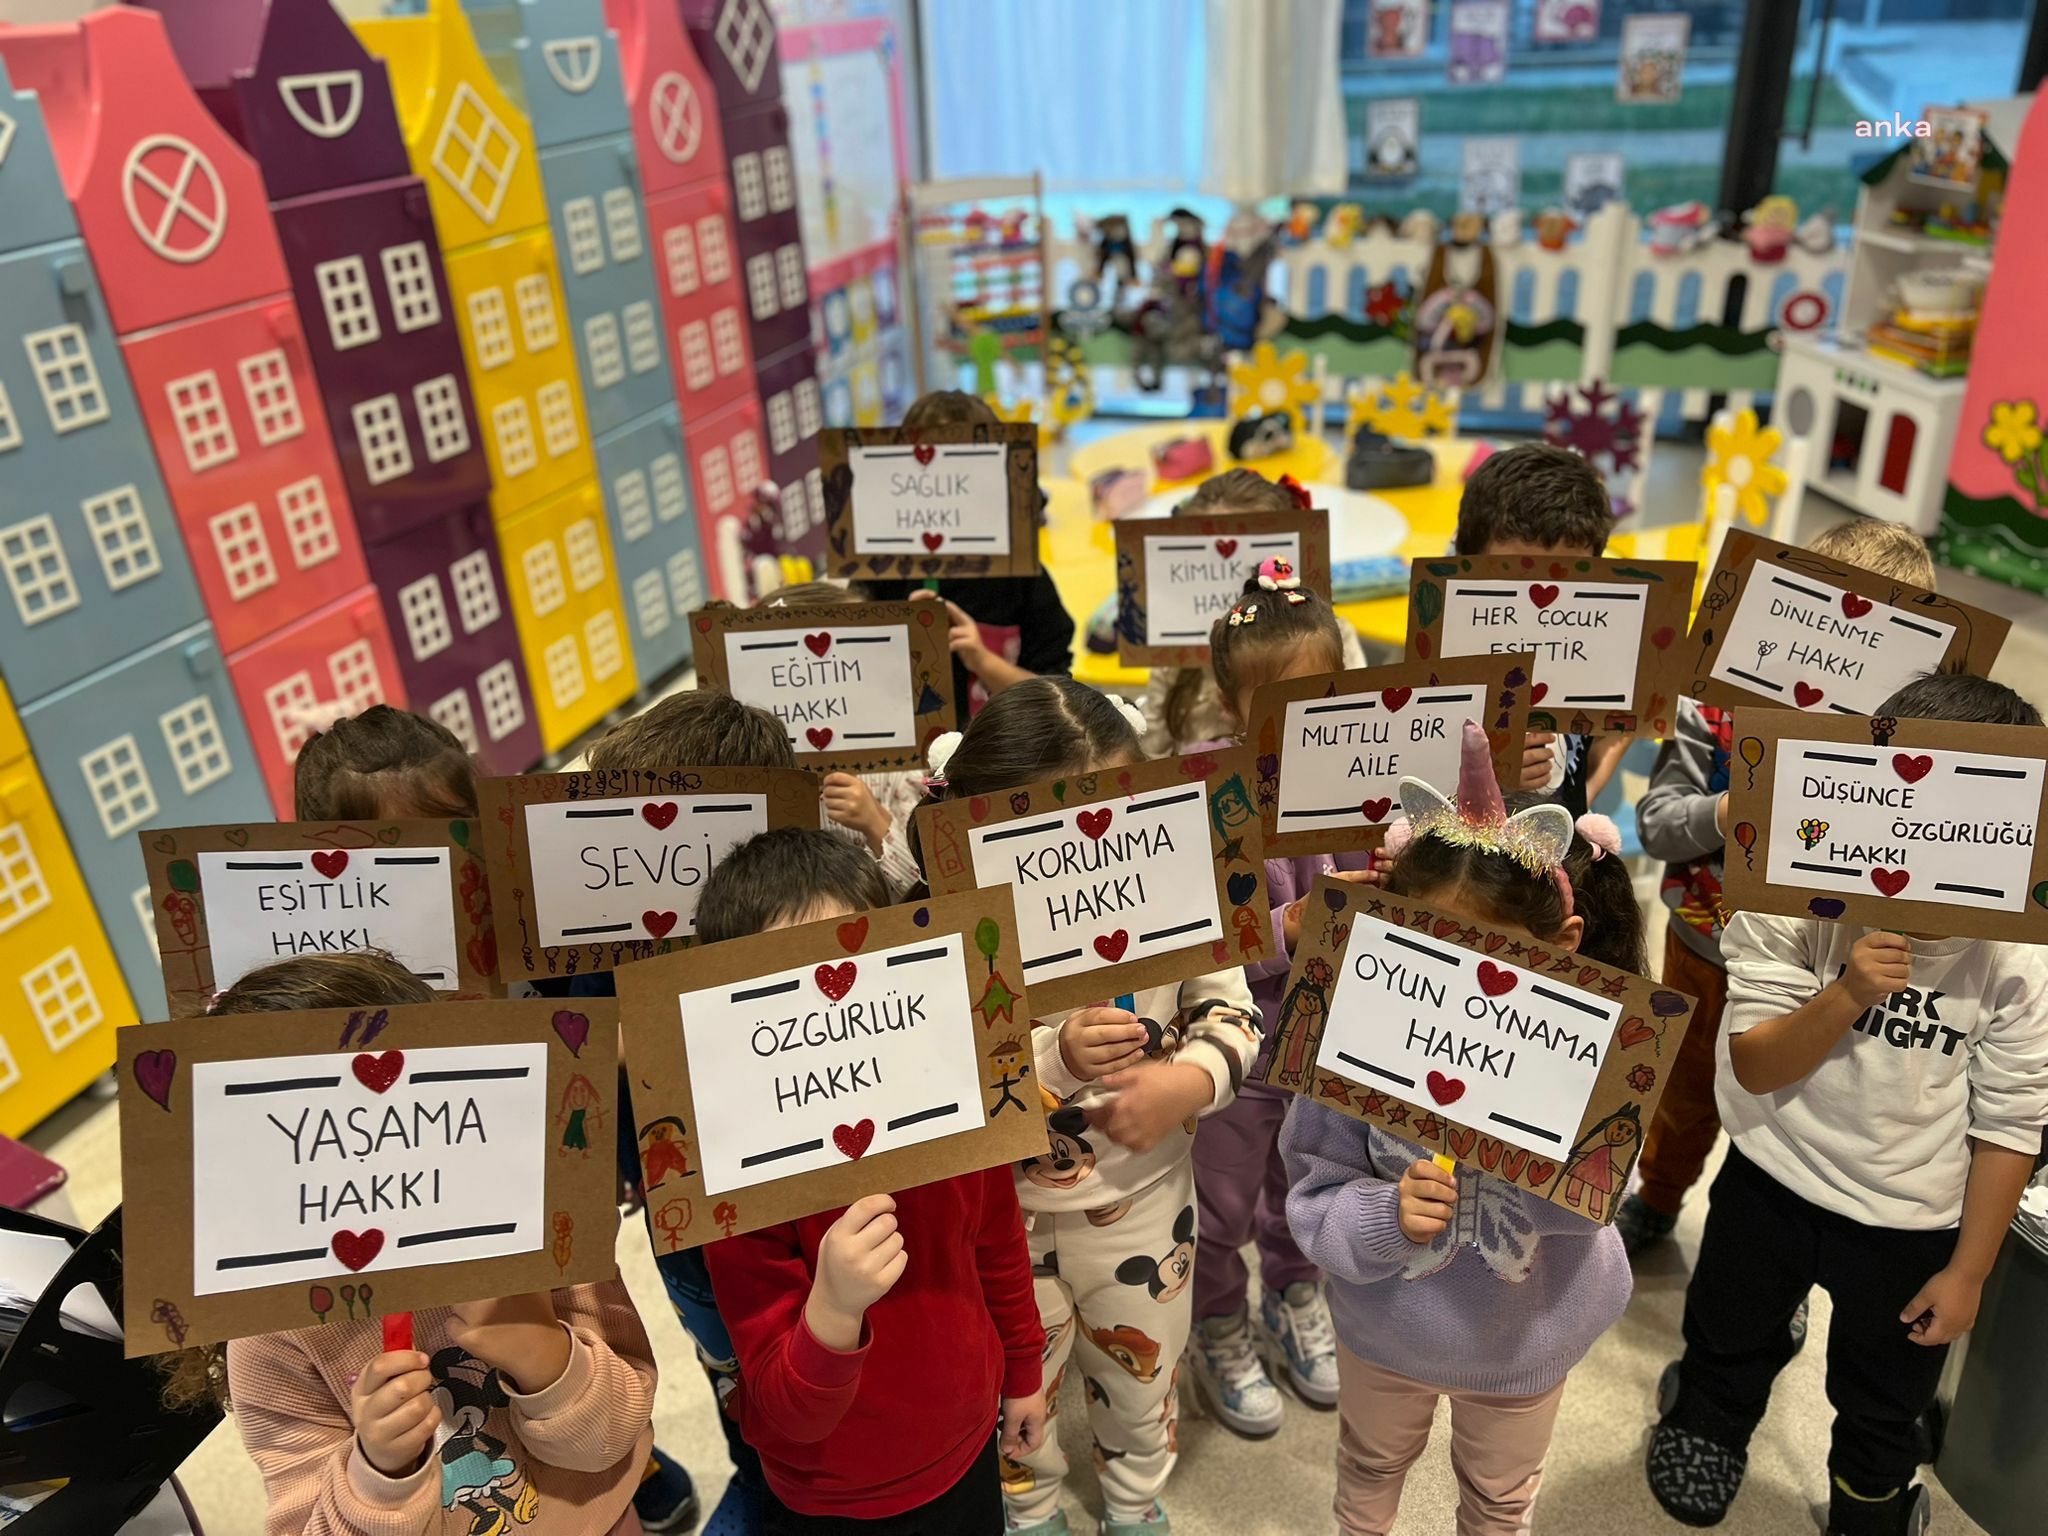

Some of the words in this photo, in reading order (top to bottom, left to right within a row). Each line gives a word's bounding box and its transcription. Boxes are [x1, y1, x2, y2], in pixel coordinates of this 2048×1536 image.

[891, 467, 969, 498] SAĞLIK
[896, 509, 960, 529] HAKKI
[1193, 592, 1240, 615] HAK
[1473, 606, 1517, 626] HER
[1537, 609, 1608, 628] ÇOCUK
[1769, 597, 1885, 651] DİNLENME
[772, 655, 861, 687] EĞİTİM
[1788, 642, 1864, 680] HAKKI
[773, 697, 847, 724] HAKKI
[1302, 722, 1389, 747] MUTLU
[1410, 713, 1445, 742] BİR
[1348, 753, 1399, 777] AİLE
[1803, 774, 1915, 809] DÜŞÜNCE
[1892, 817, 2033, 847] ÖZGÜRLÜĞÜ
[581, 834, 712, 890] SEVGİ
[1016, 823, 1174, 885] KORUNMA
[1829, 843, 1906, 865] HAKKI
[259, 877, 389, 915] EŞİTLİK
[1047, 873, 1145, 932] HAKKI
[272, 928, 370, 955] HAKKI
[751, 990, 926, 1056] ÖZGÜRLÜK
[1356, 953, 1447, 1008] OYUN
[1464, 996, 1599, 1068] OYNAMA
[1405, 1018, 1515, 1080] HAKKI
[775, 1057, 881, 1112] HAKKI
[267, 1098, 486, 1164] YAŞAMA
[300, 1169, 439, 1225] HAKKI
